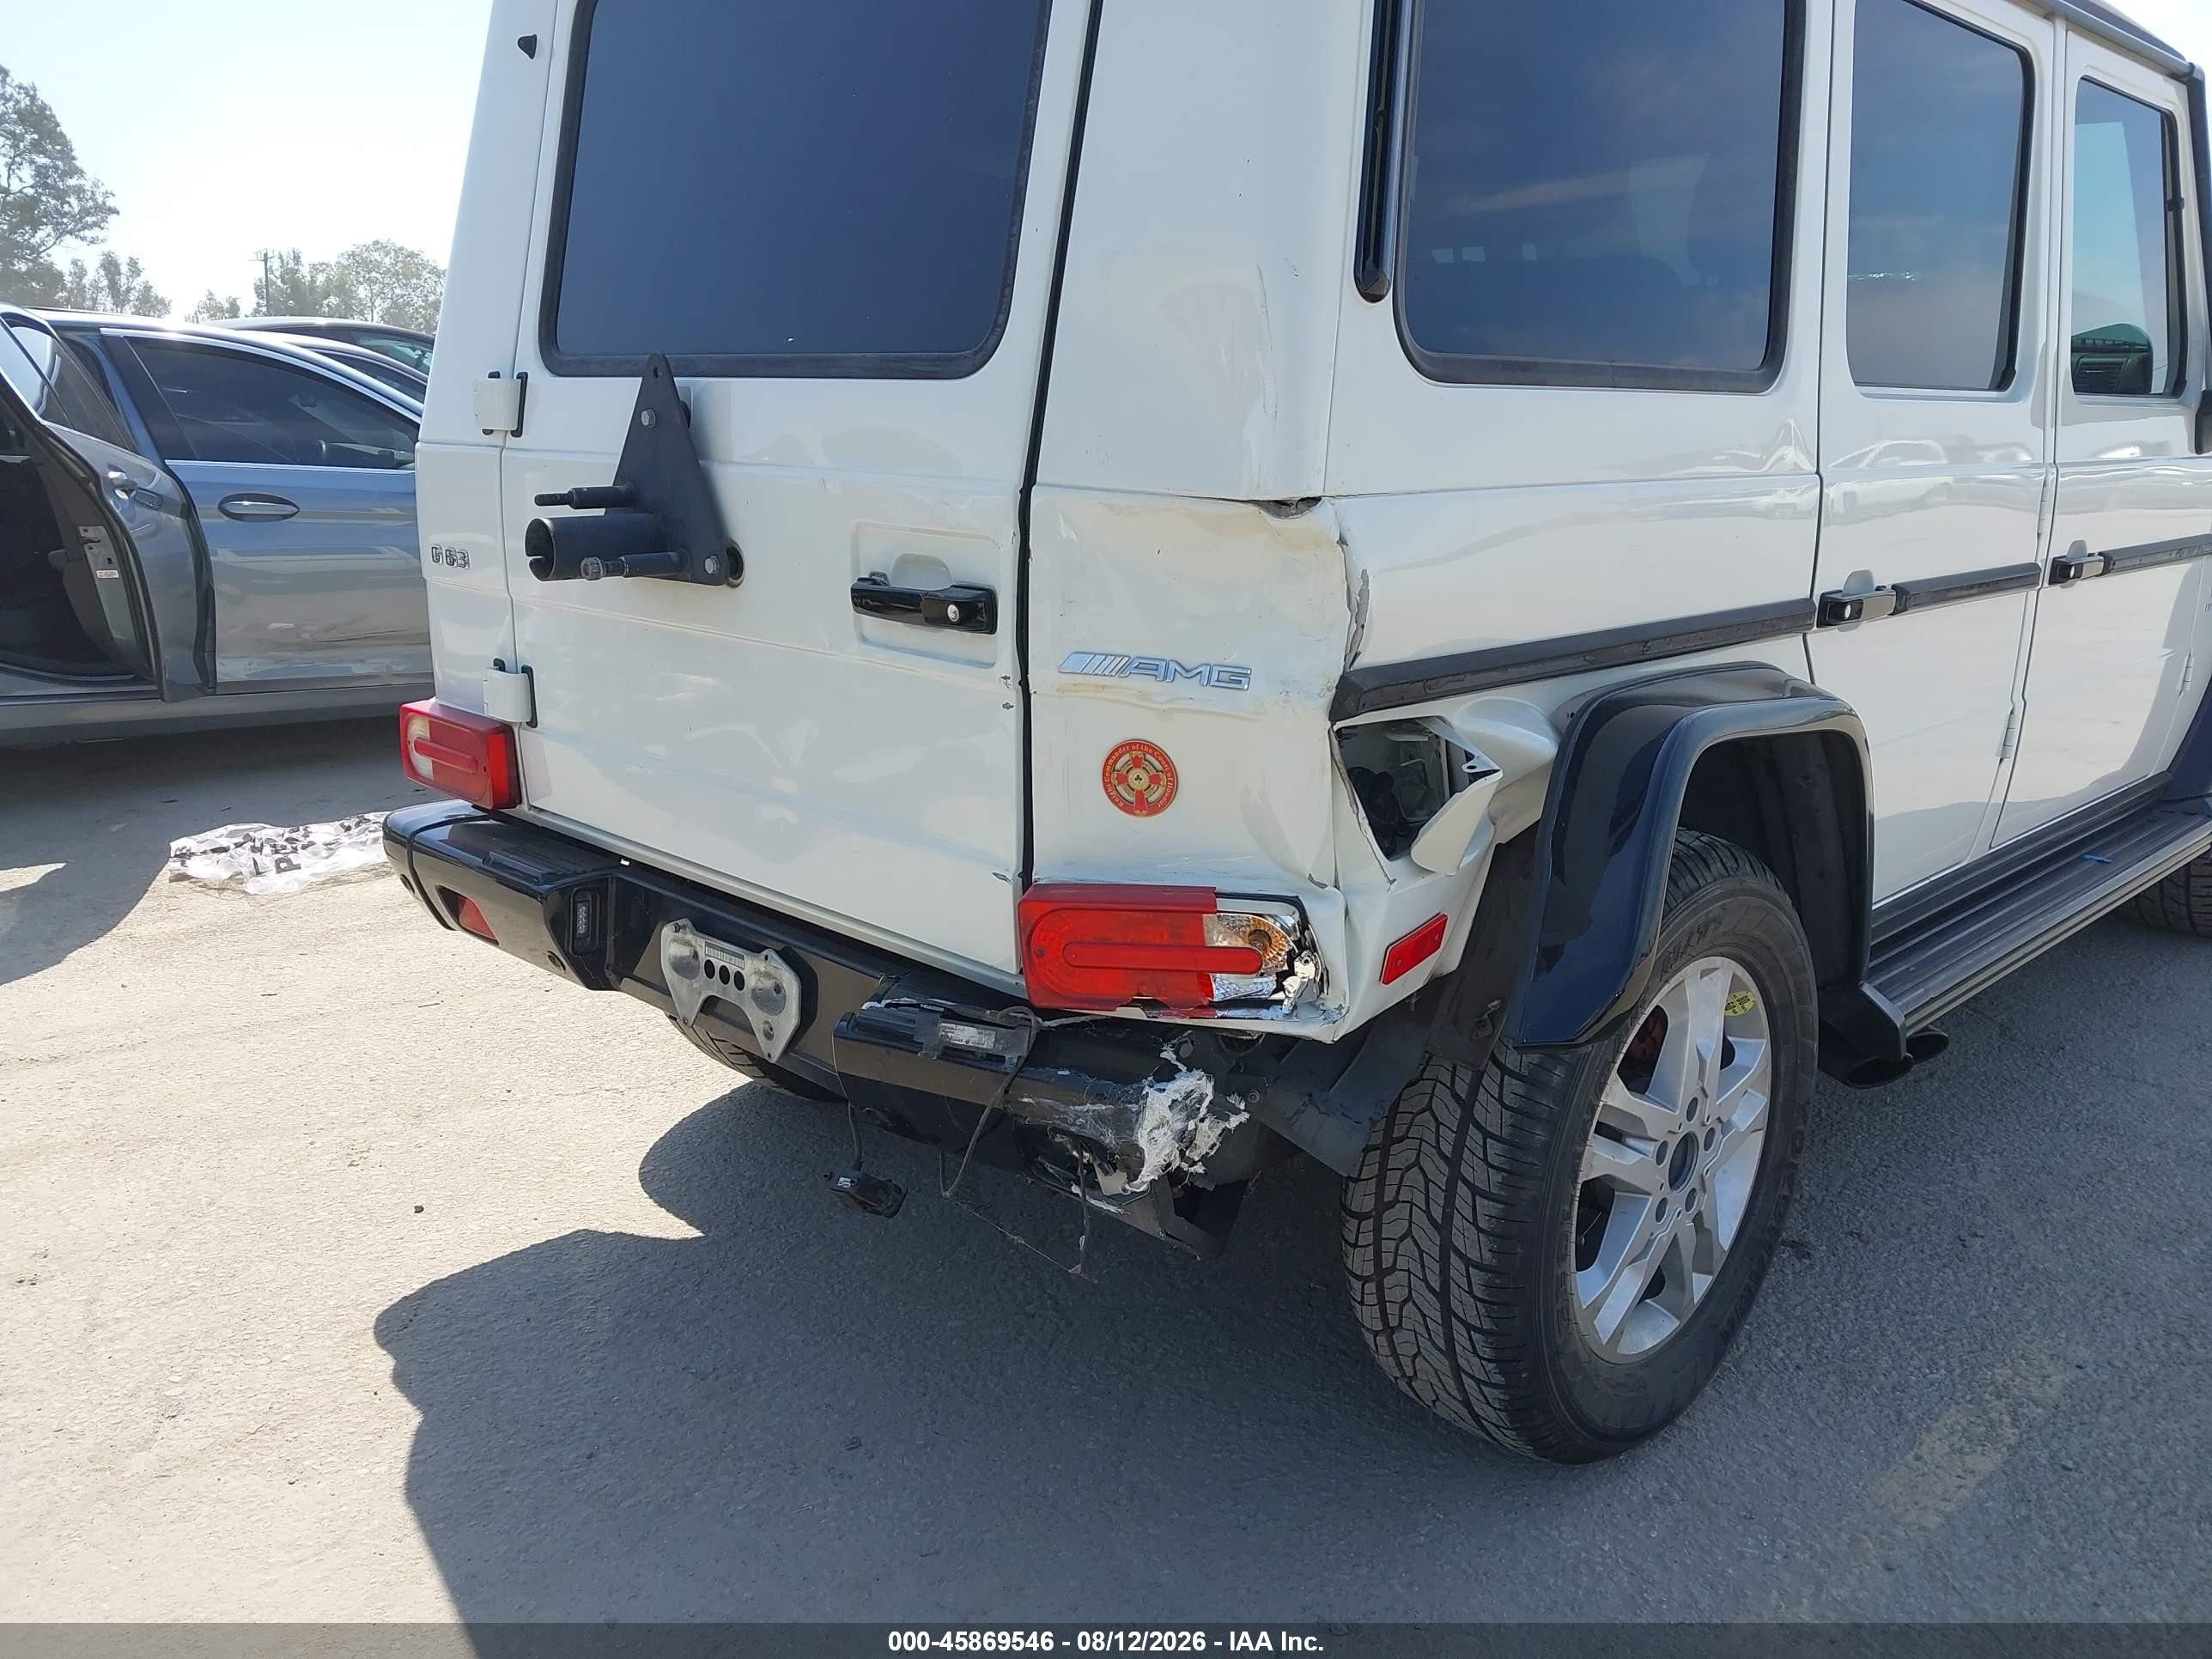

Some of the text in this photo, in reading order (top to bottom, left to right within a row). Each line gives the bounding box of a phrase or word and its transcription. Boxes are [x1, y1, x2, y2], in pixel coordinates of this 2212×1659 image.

[431, 544, 470, 569] G 63
[1119, 656, 1252, 690] AMG
[1140, 744, 1153, 753] the
[1104, 745, 1129, 782] Commander
[1153, 751, 1170, 772] Court
[1105, 784, 1125, 807] Knight
[1157, 781, 1174, 808] Honour
